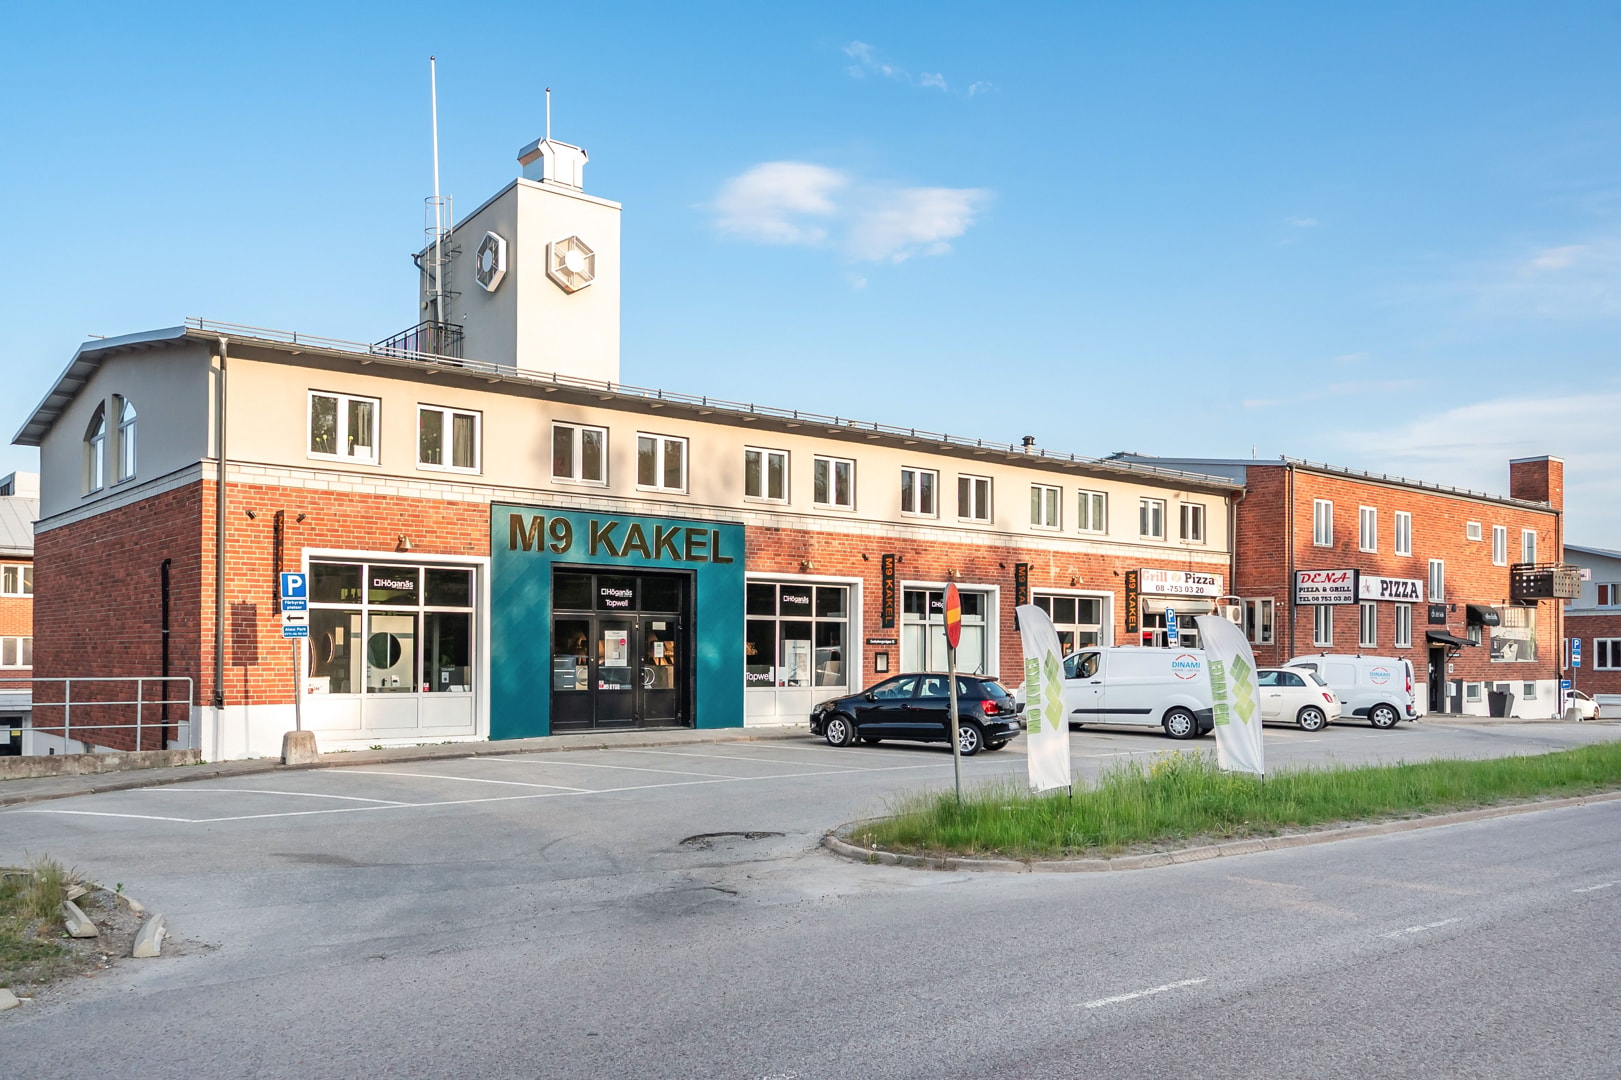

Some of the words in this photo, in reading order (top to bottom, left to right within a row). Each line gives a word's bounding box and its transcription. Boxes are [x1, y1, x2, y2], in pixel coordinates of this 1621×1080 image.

[508, 513, 573, 554] M9
[589, 519, 734, 564] KAKEL
[885, 557, 893, 576] M9
[1018, 566, 1026, 582] M9
[287, 575, 303, 596] P
[381, 579, 414, 588] Höganäs
[1128, 573, 1136, 589] M9
[1142, 570, 1168, 582] Grill
[1184, 573, 1215, 585] Pizza
[1300, 572, 1350, 584] DENA
[1195, 586, 1204, 594] 20
[1380, 580, 1419, 598] PIZZA
[605, 599, 629, 608] Topwell
[885, 580, 893, 624] KAKEL
[1128, 592, 1136, 630] KAKEL
[1167, 609, 1174, 622] P
[1574, 639, 1580, 649] P
